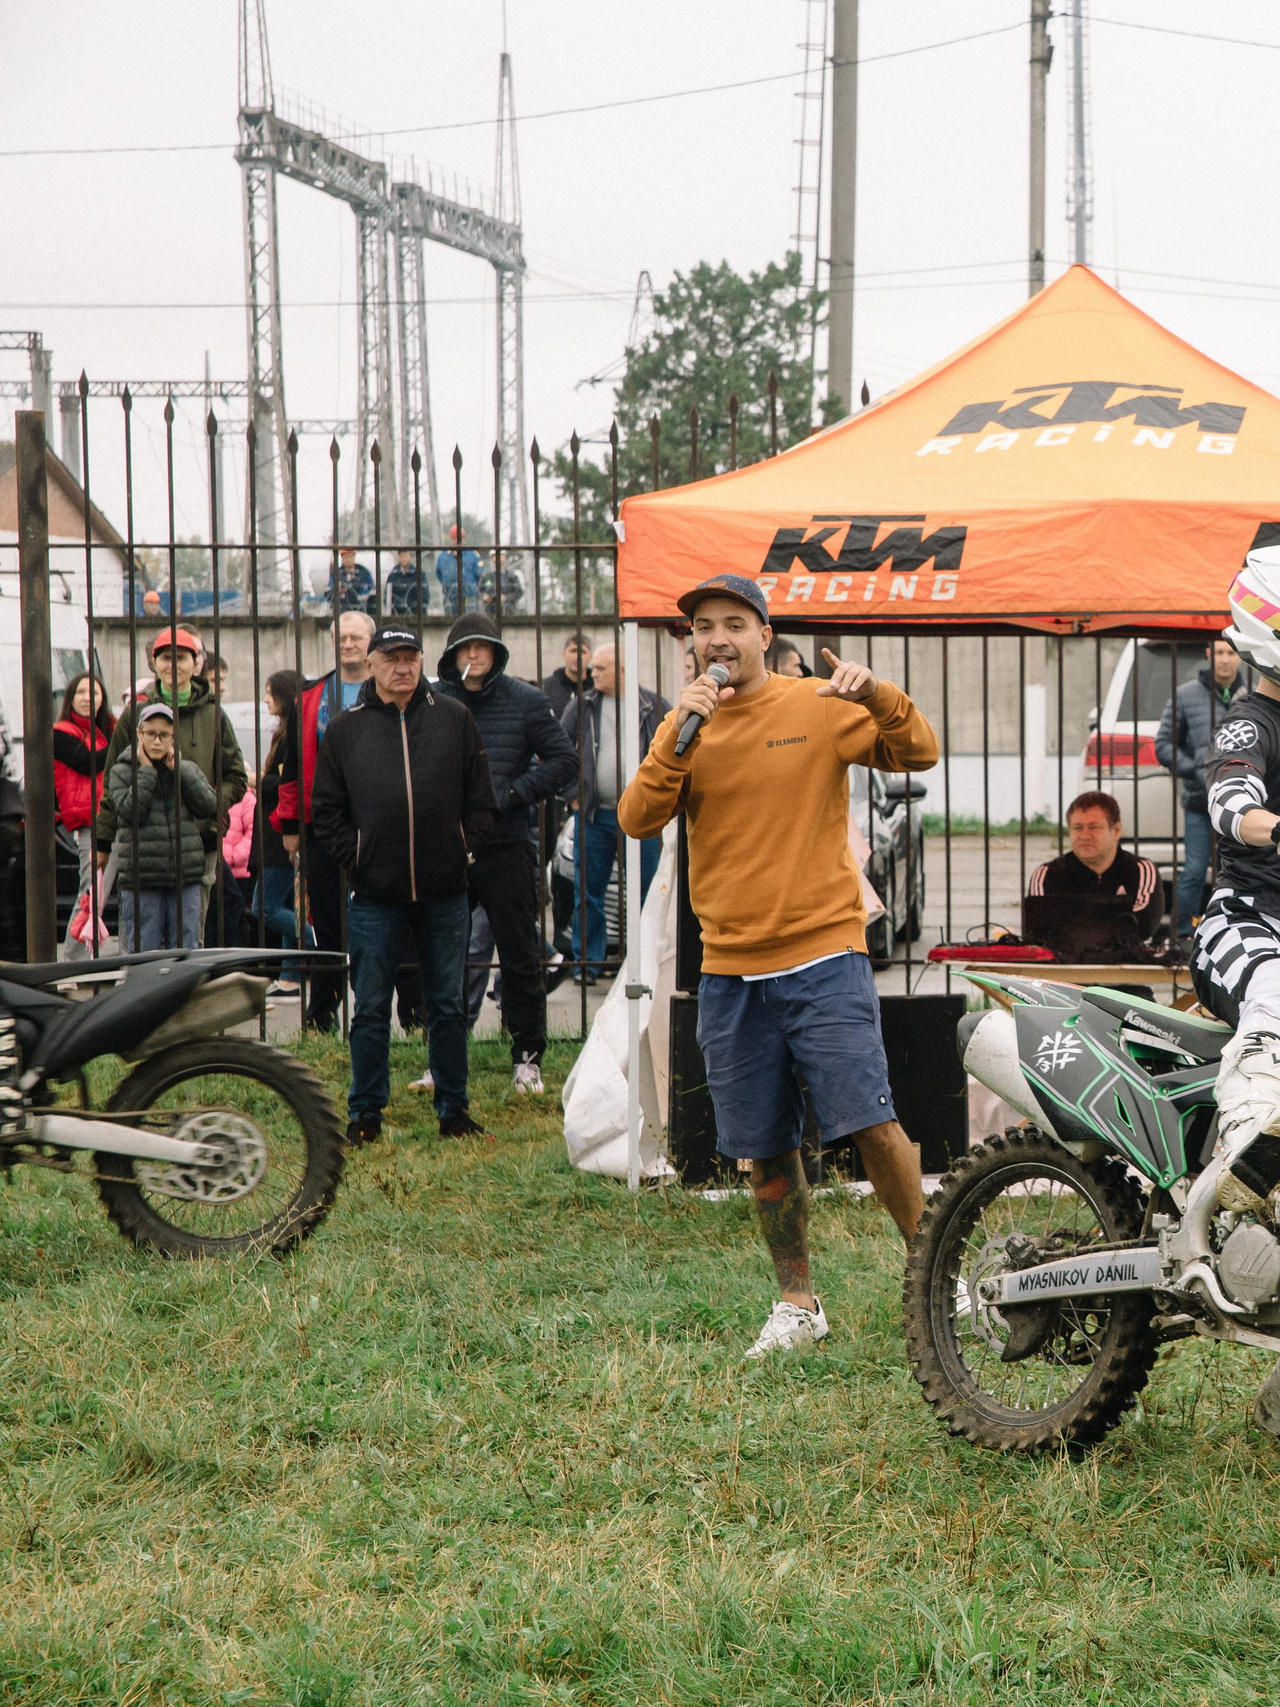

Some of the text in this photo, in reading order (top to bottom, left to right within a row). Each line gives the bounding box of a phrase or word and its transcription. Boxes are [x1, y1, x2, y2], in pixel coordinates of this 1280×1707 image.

[936, 380, 1247, 437] KTM
[760, 515, 968, 573] KTM
[776, 735, 807, 747] ELEMENT
[1124, 1009, 1182, 1046] Kawasaki
[1019, 1264, 1139, 1291] MYASNIKOV DANIIL
